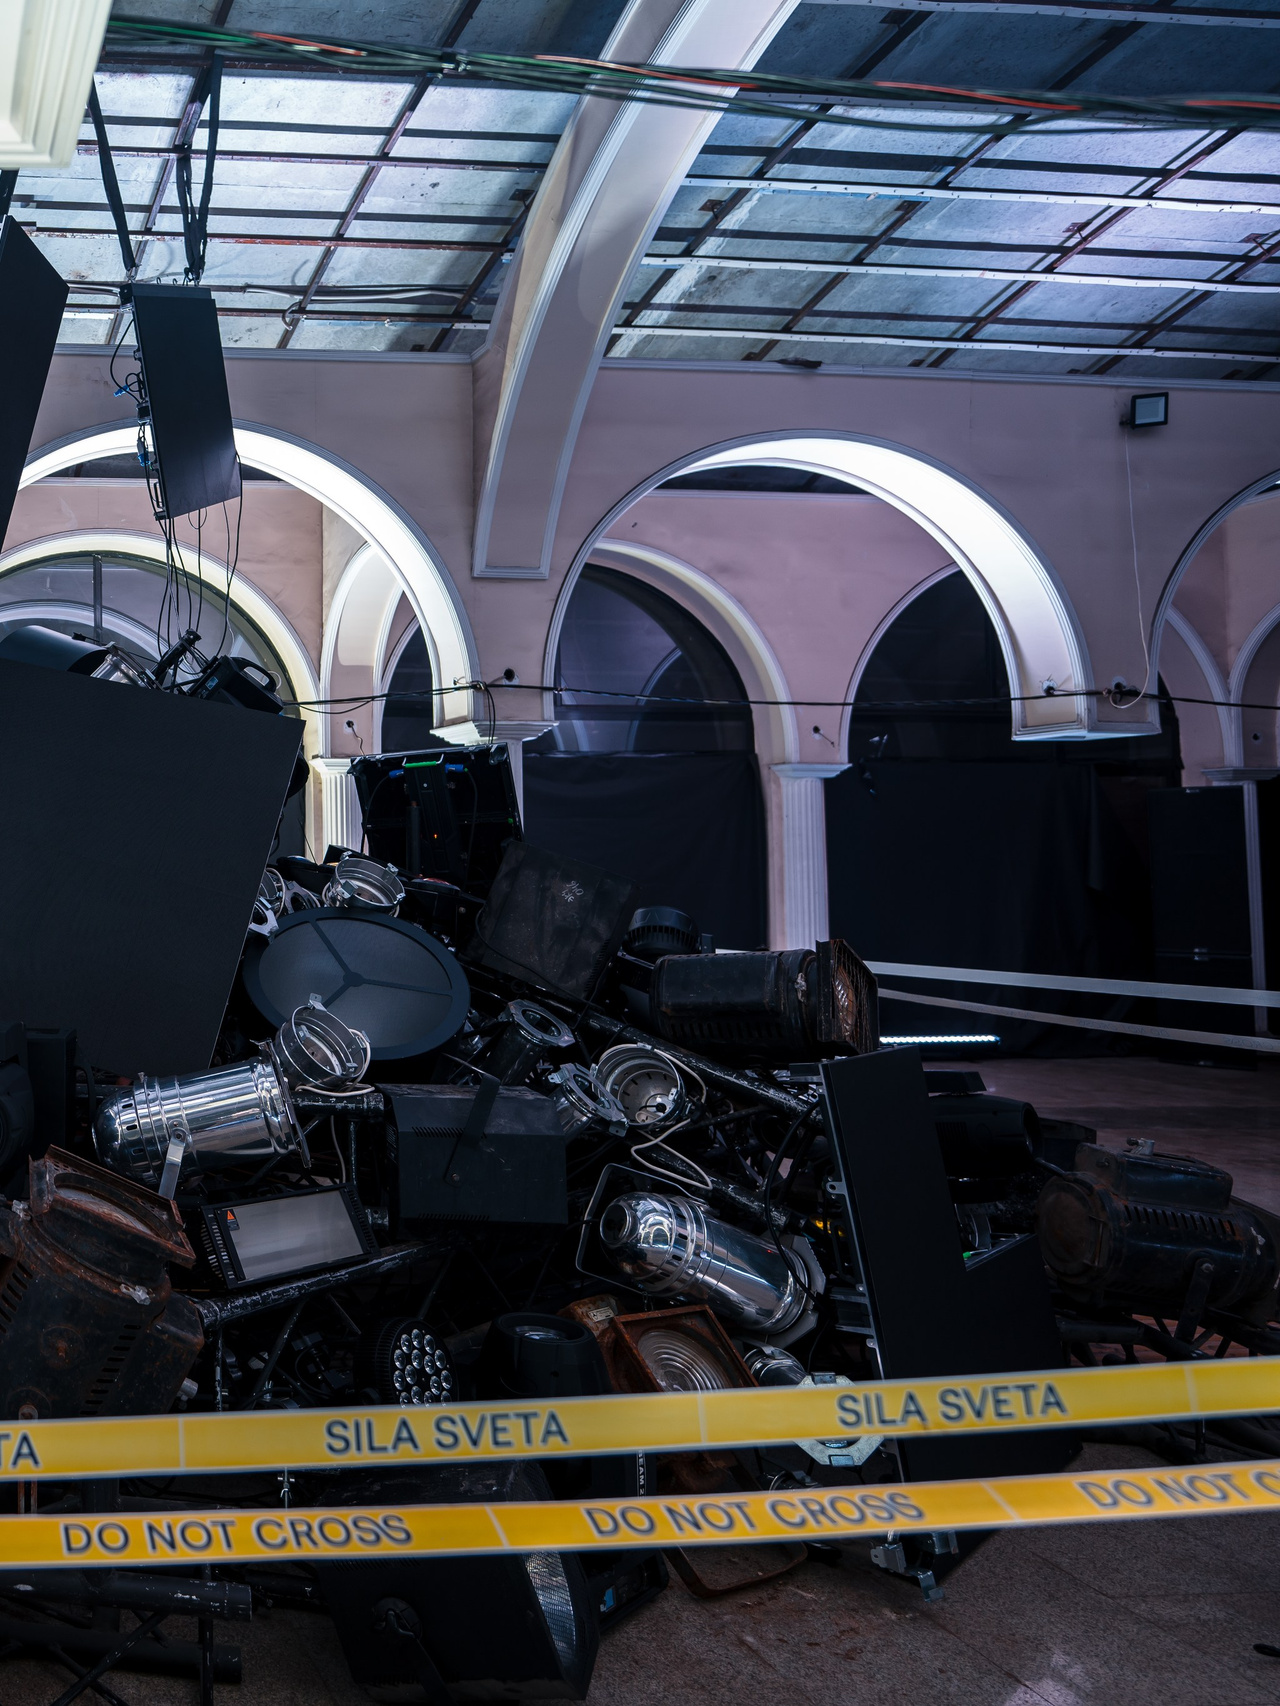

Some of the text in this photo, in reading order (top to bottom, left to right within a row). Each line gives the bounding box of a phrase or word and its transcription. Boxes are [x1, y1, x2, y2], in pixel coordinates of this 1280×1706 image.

[837, 1382, 1068, 1427] SILA SVETA
[325, 1409, 569, 1454] SILA SVETA
[1075, 1479, 1154, 1508] DO
[1150, 1473, 1250, 1504] NOT
[61, 1514, 412, 1555] DO NOT CROSS
[584, 1492, 924, 1536] DO NOT CROSS
